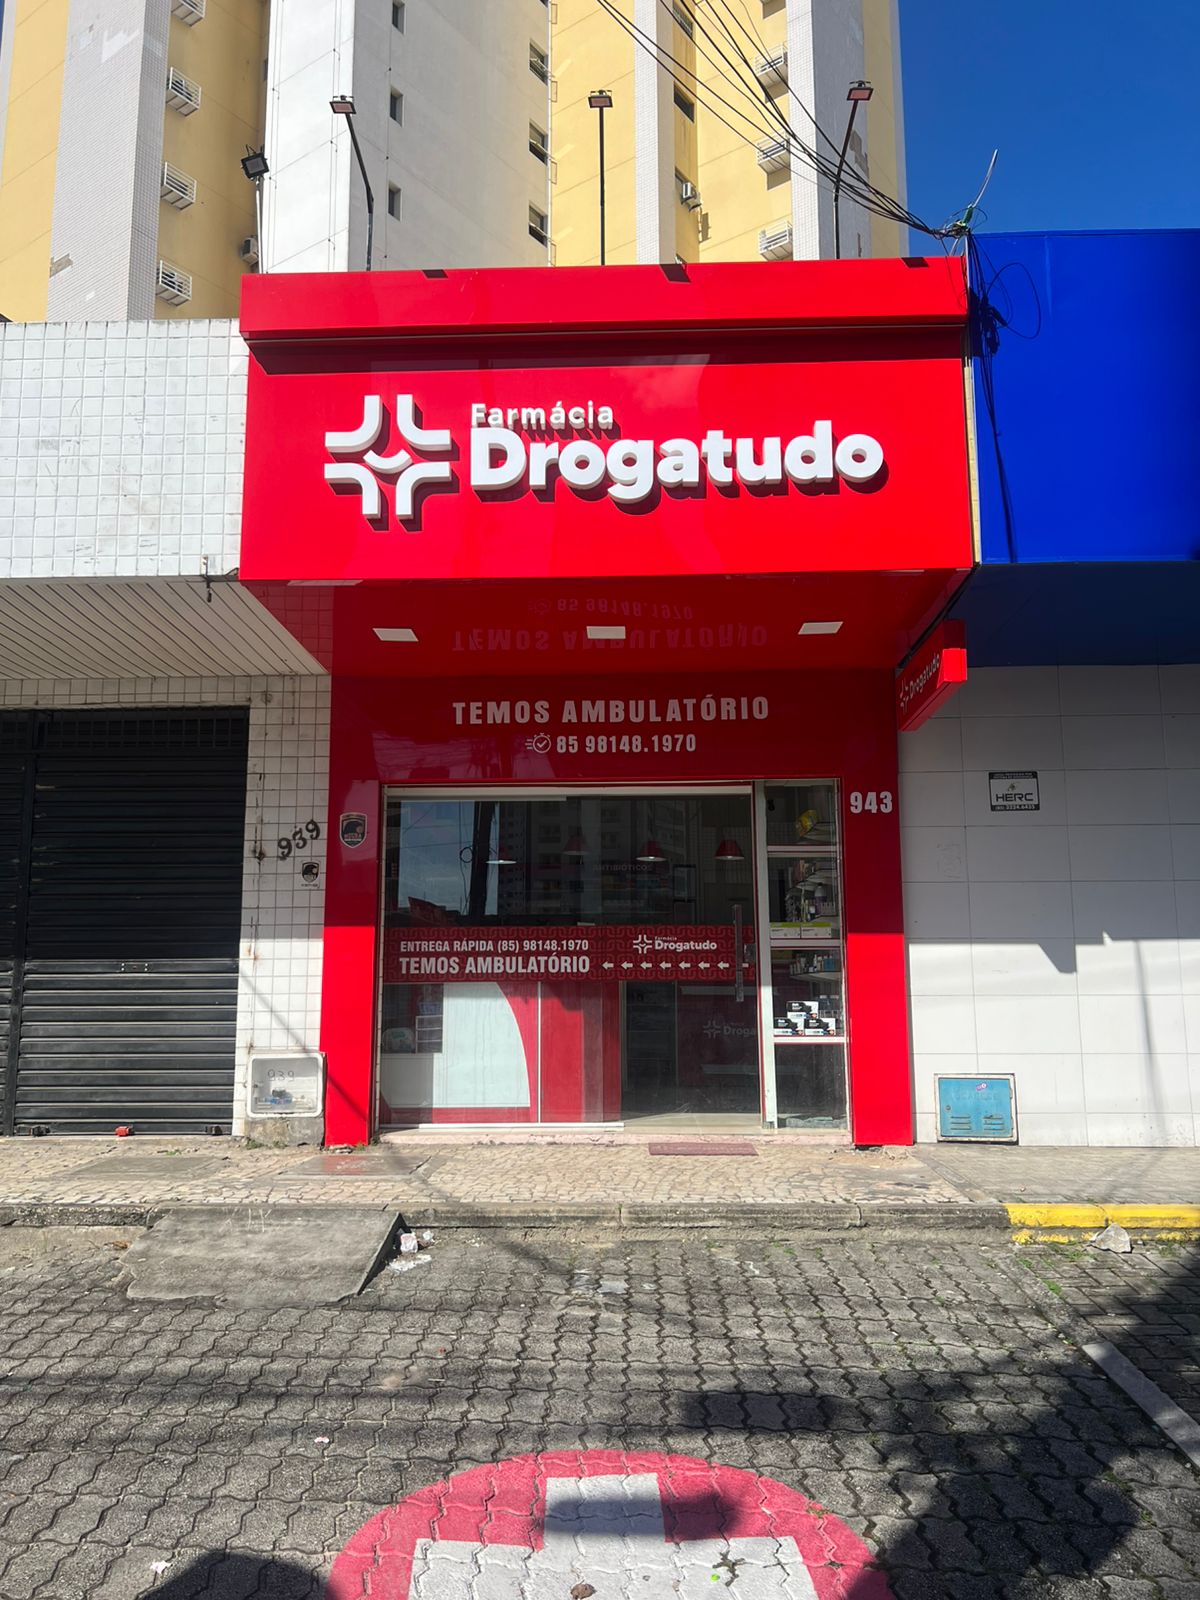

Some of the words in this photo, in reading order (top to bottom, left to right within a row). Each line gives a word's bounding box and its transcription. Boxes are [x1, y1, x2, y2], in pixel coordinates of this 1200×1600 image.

[470, 400, 615, 430] Farmácia
[470, 419, 885, 503] Drogatudo
[909, 652, 940, 699] Drogatudo
[453, 700, 550, 724] TEMOS
[562, 694, 769, 723] AMBULATÓRIO
[556, 736, 578, 753] 85
[585, 734, 697, 753] 98148.1970
[850, 791, 893, 814] 943
[995, 793, 1034, 802] HERC
[277, 819, 321, 860] 939
[400, 941, 450, 952] ENTREGA
[453, 938, 494, 952] RÁPIDA
[497, 940, 519, 953] (85)
[523, 940, 589, 951] 98148.1970
[654, 940, 717, 952] Drogatudo
[400, 957, 459, 974] TEMOS
[465, 952, 590, 973] AMBULATÓRIO
